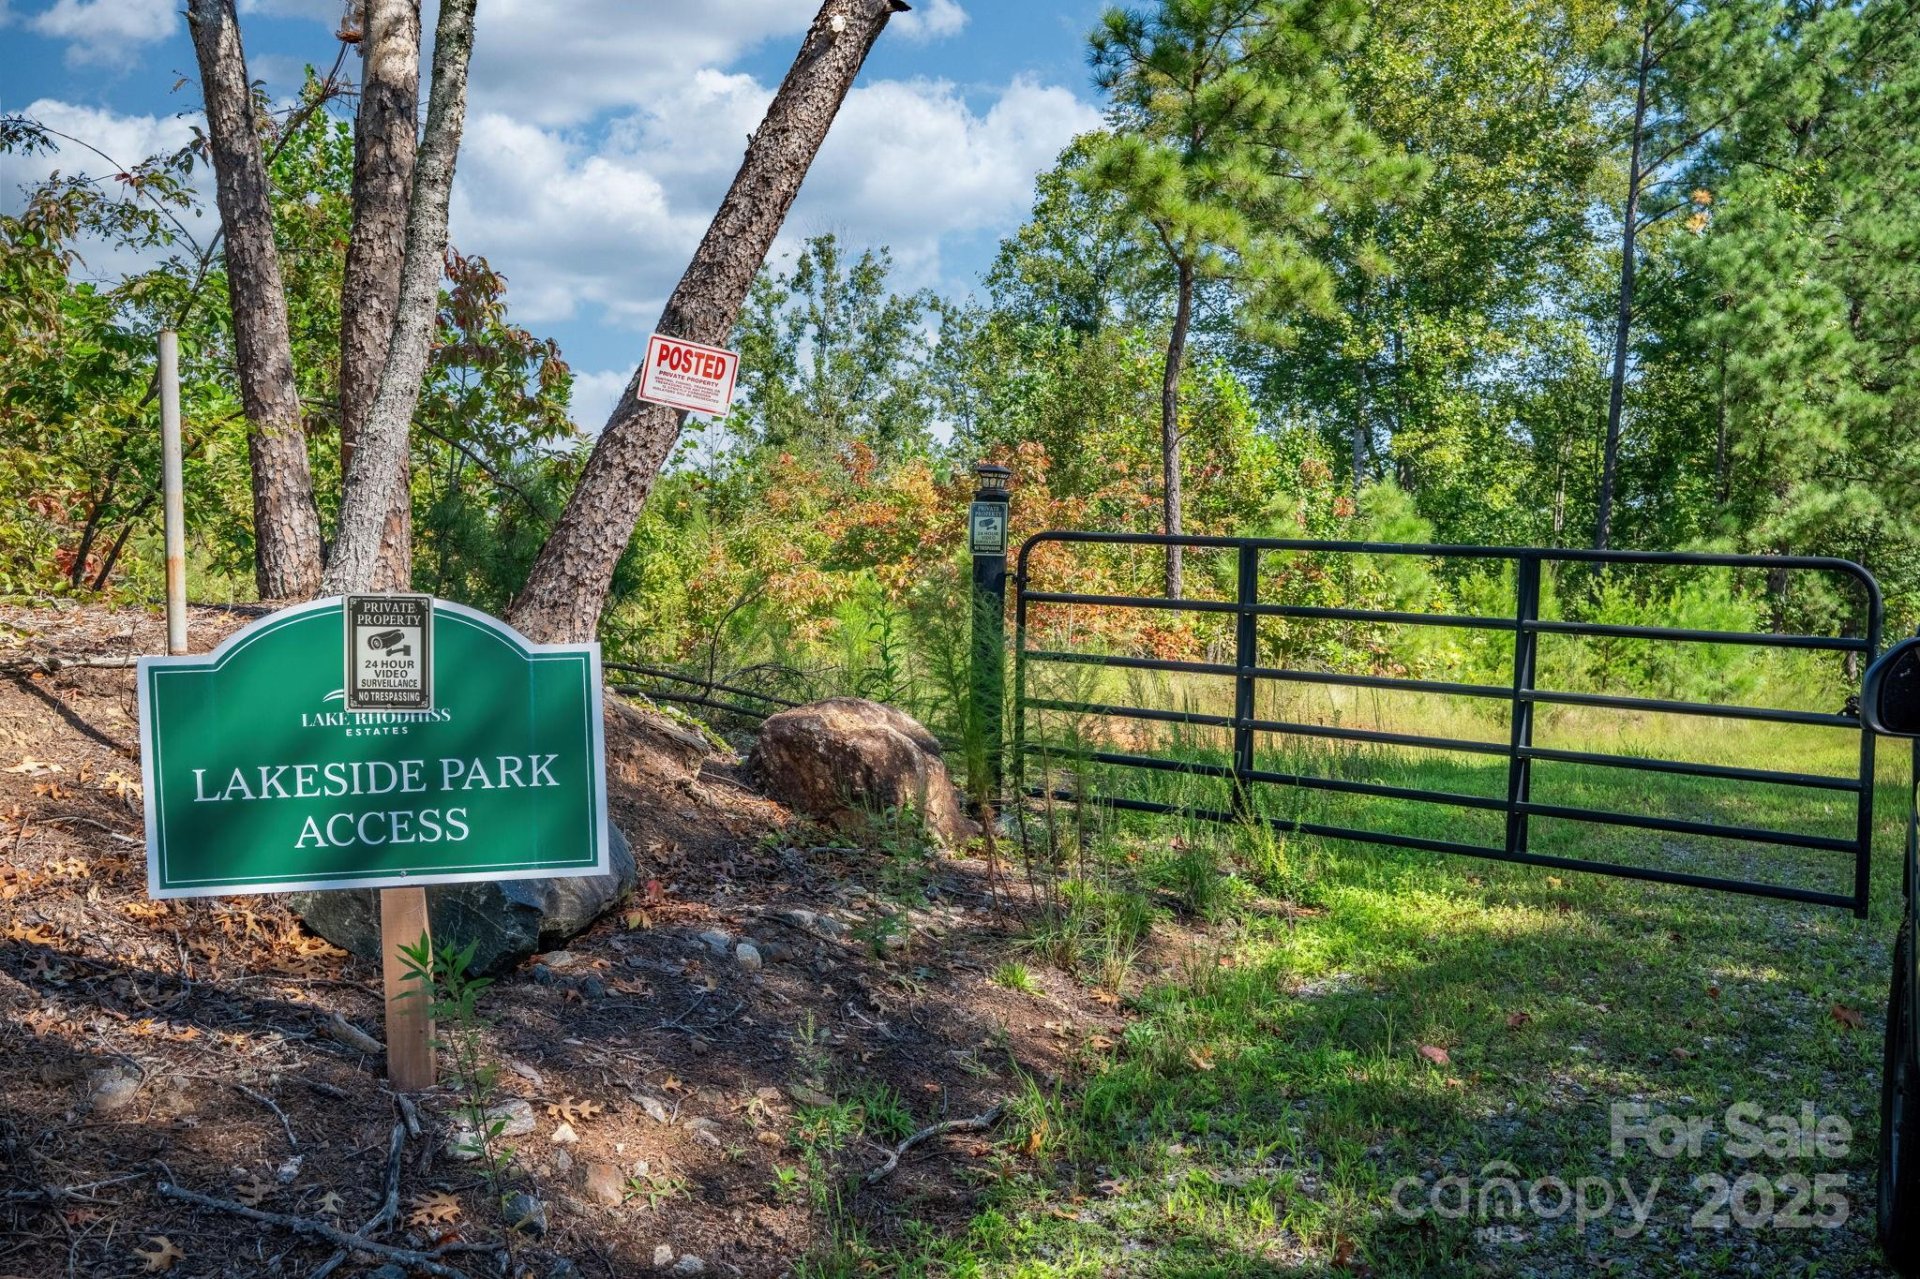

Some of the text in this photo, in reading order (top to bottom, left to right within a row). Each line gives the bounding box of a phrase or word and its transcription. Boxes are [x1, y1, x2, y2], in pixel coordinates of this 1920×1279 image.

[657, 344, 726, 380] POSTED
[658, 370, 685, 379] PRIVATE
[687, 376, 719, 387] PROPERTY
[363, 602, 417, 613] PRIVATE
[357, 614, 422, 626] PROPERTY
[365, 660, 415, 669] 24 HOUR
[374, 669, 408, 679] VIDEO
[361, 679, 418, 688] SURVEILLANCE
[358, 691, 421, 702] NO TRESPASSING
[302, 711, 350, 728] LAKE
[346, 726, 409, 737] ESTATES
[192, 754, 561, 802] LAKESIDE PARK
[294, 807, 470, 849] ACCESS
